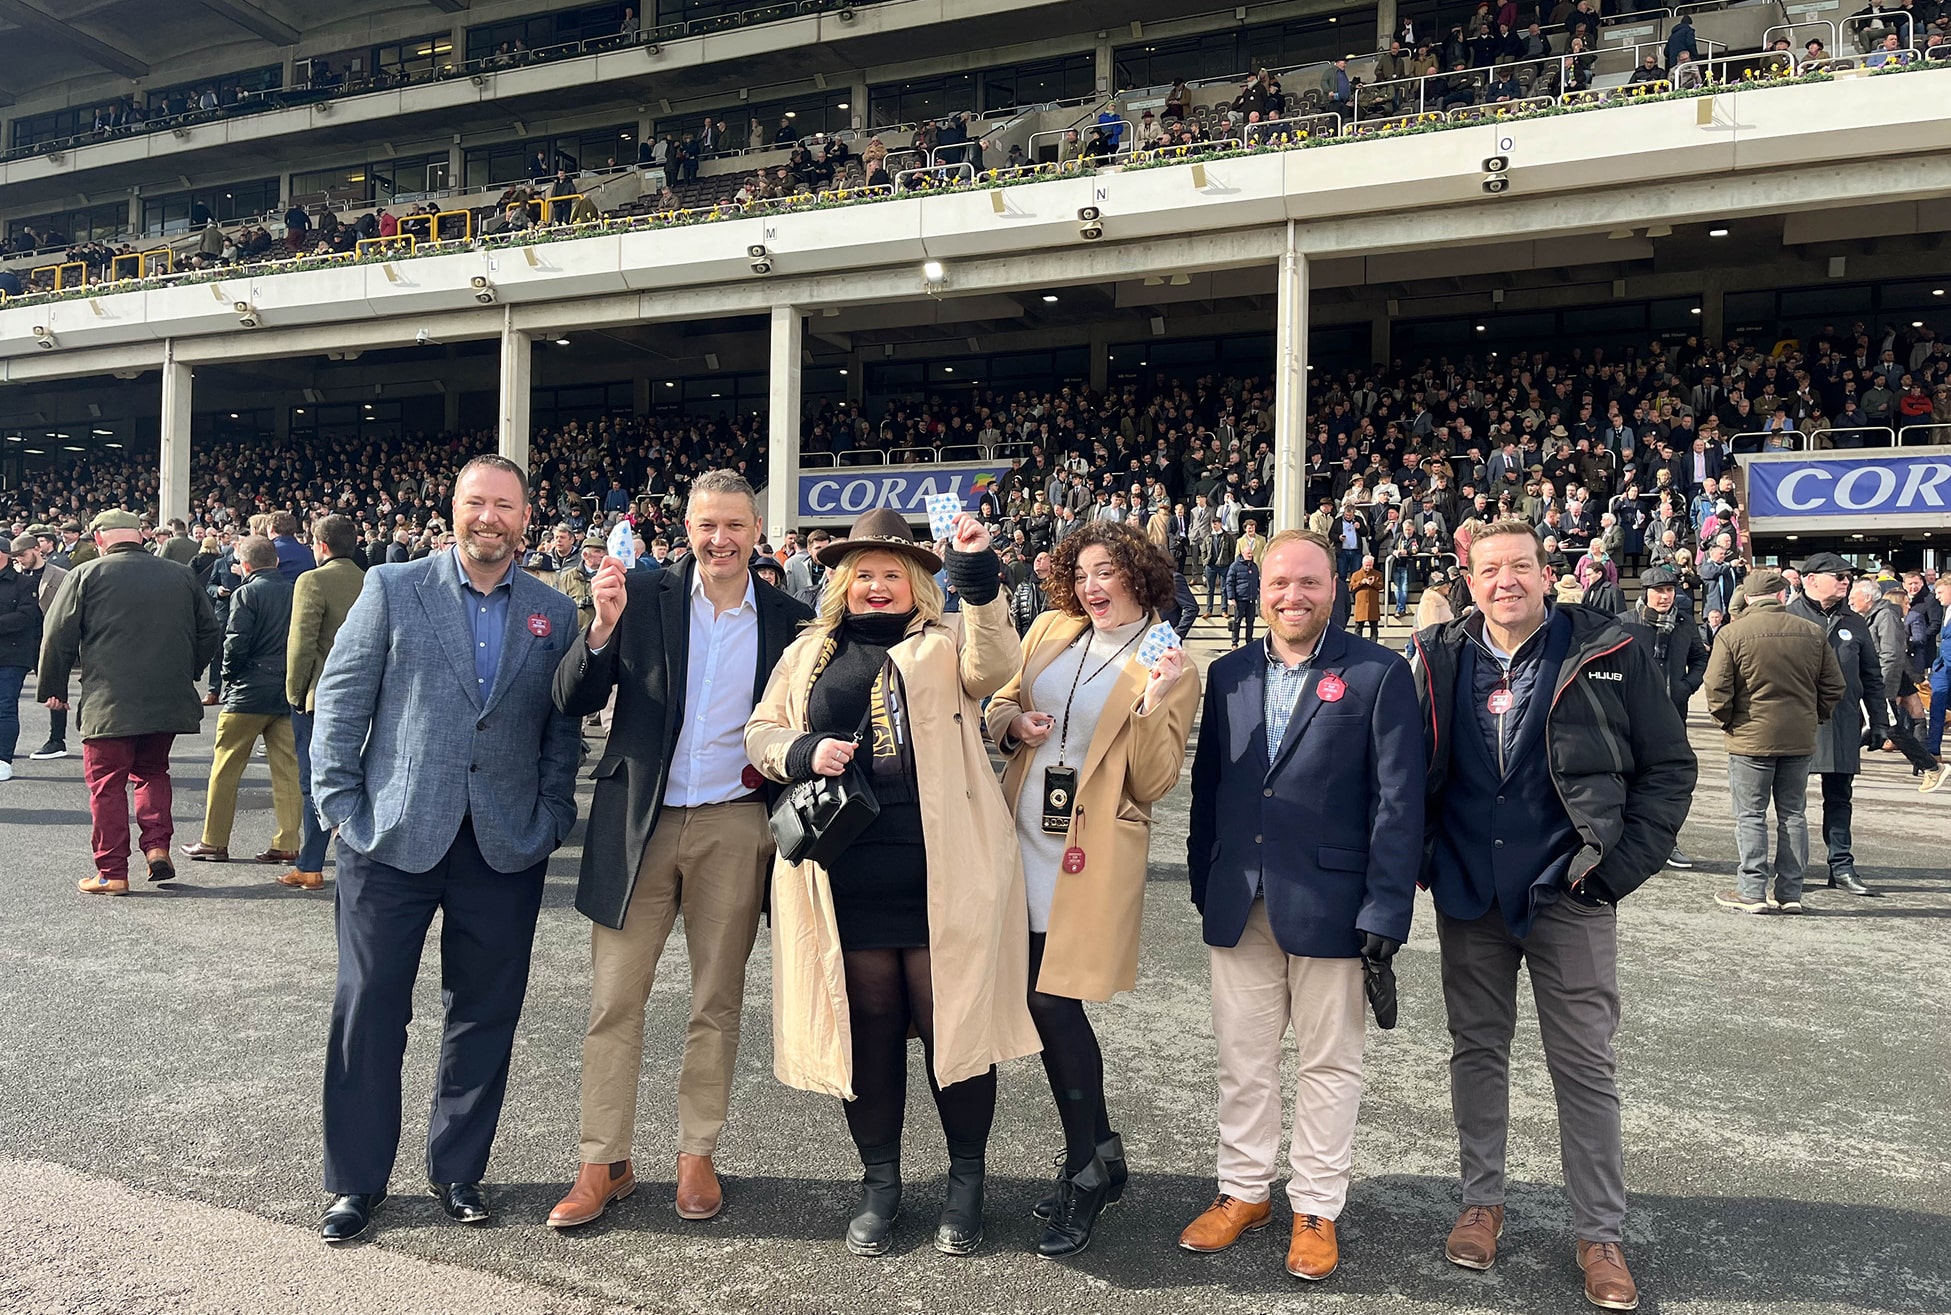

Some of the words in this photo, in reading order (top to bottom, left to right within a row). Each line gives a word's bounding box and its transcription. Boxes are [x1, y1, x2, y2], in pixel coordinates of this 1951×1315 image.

[1500, 137, 1513, 150] O
[1097, 188, 1106, 200] N
[766, 228, 776, 239] M
[491, 261, 497, 270] L
[253, 287, 259, 296] K
[808, 475, 968, 512] CORAL
[1588, 671, 1623, 681] HUUB
